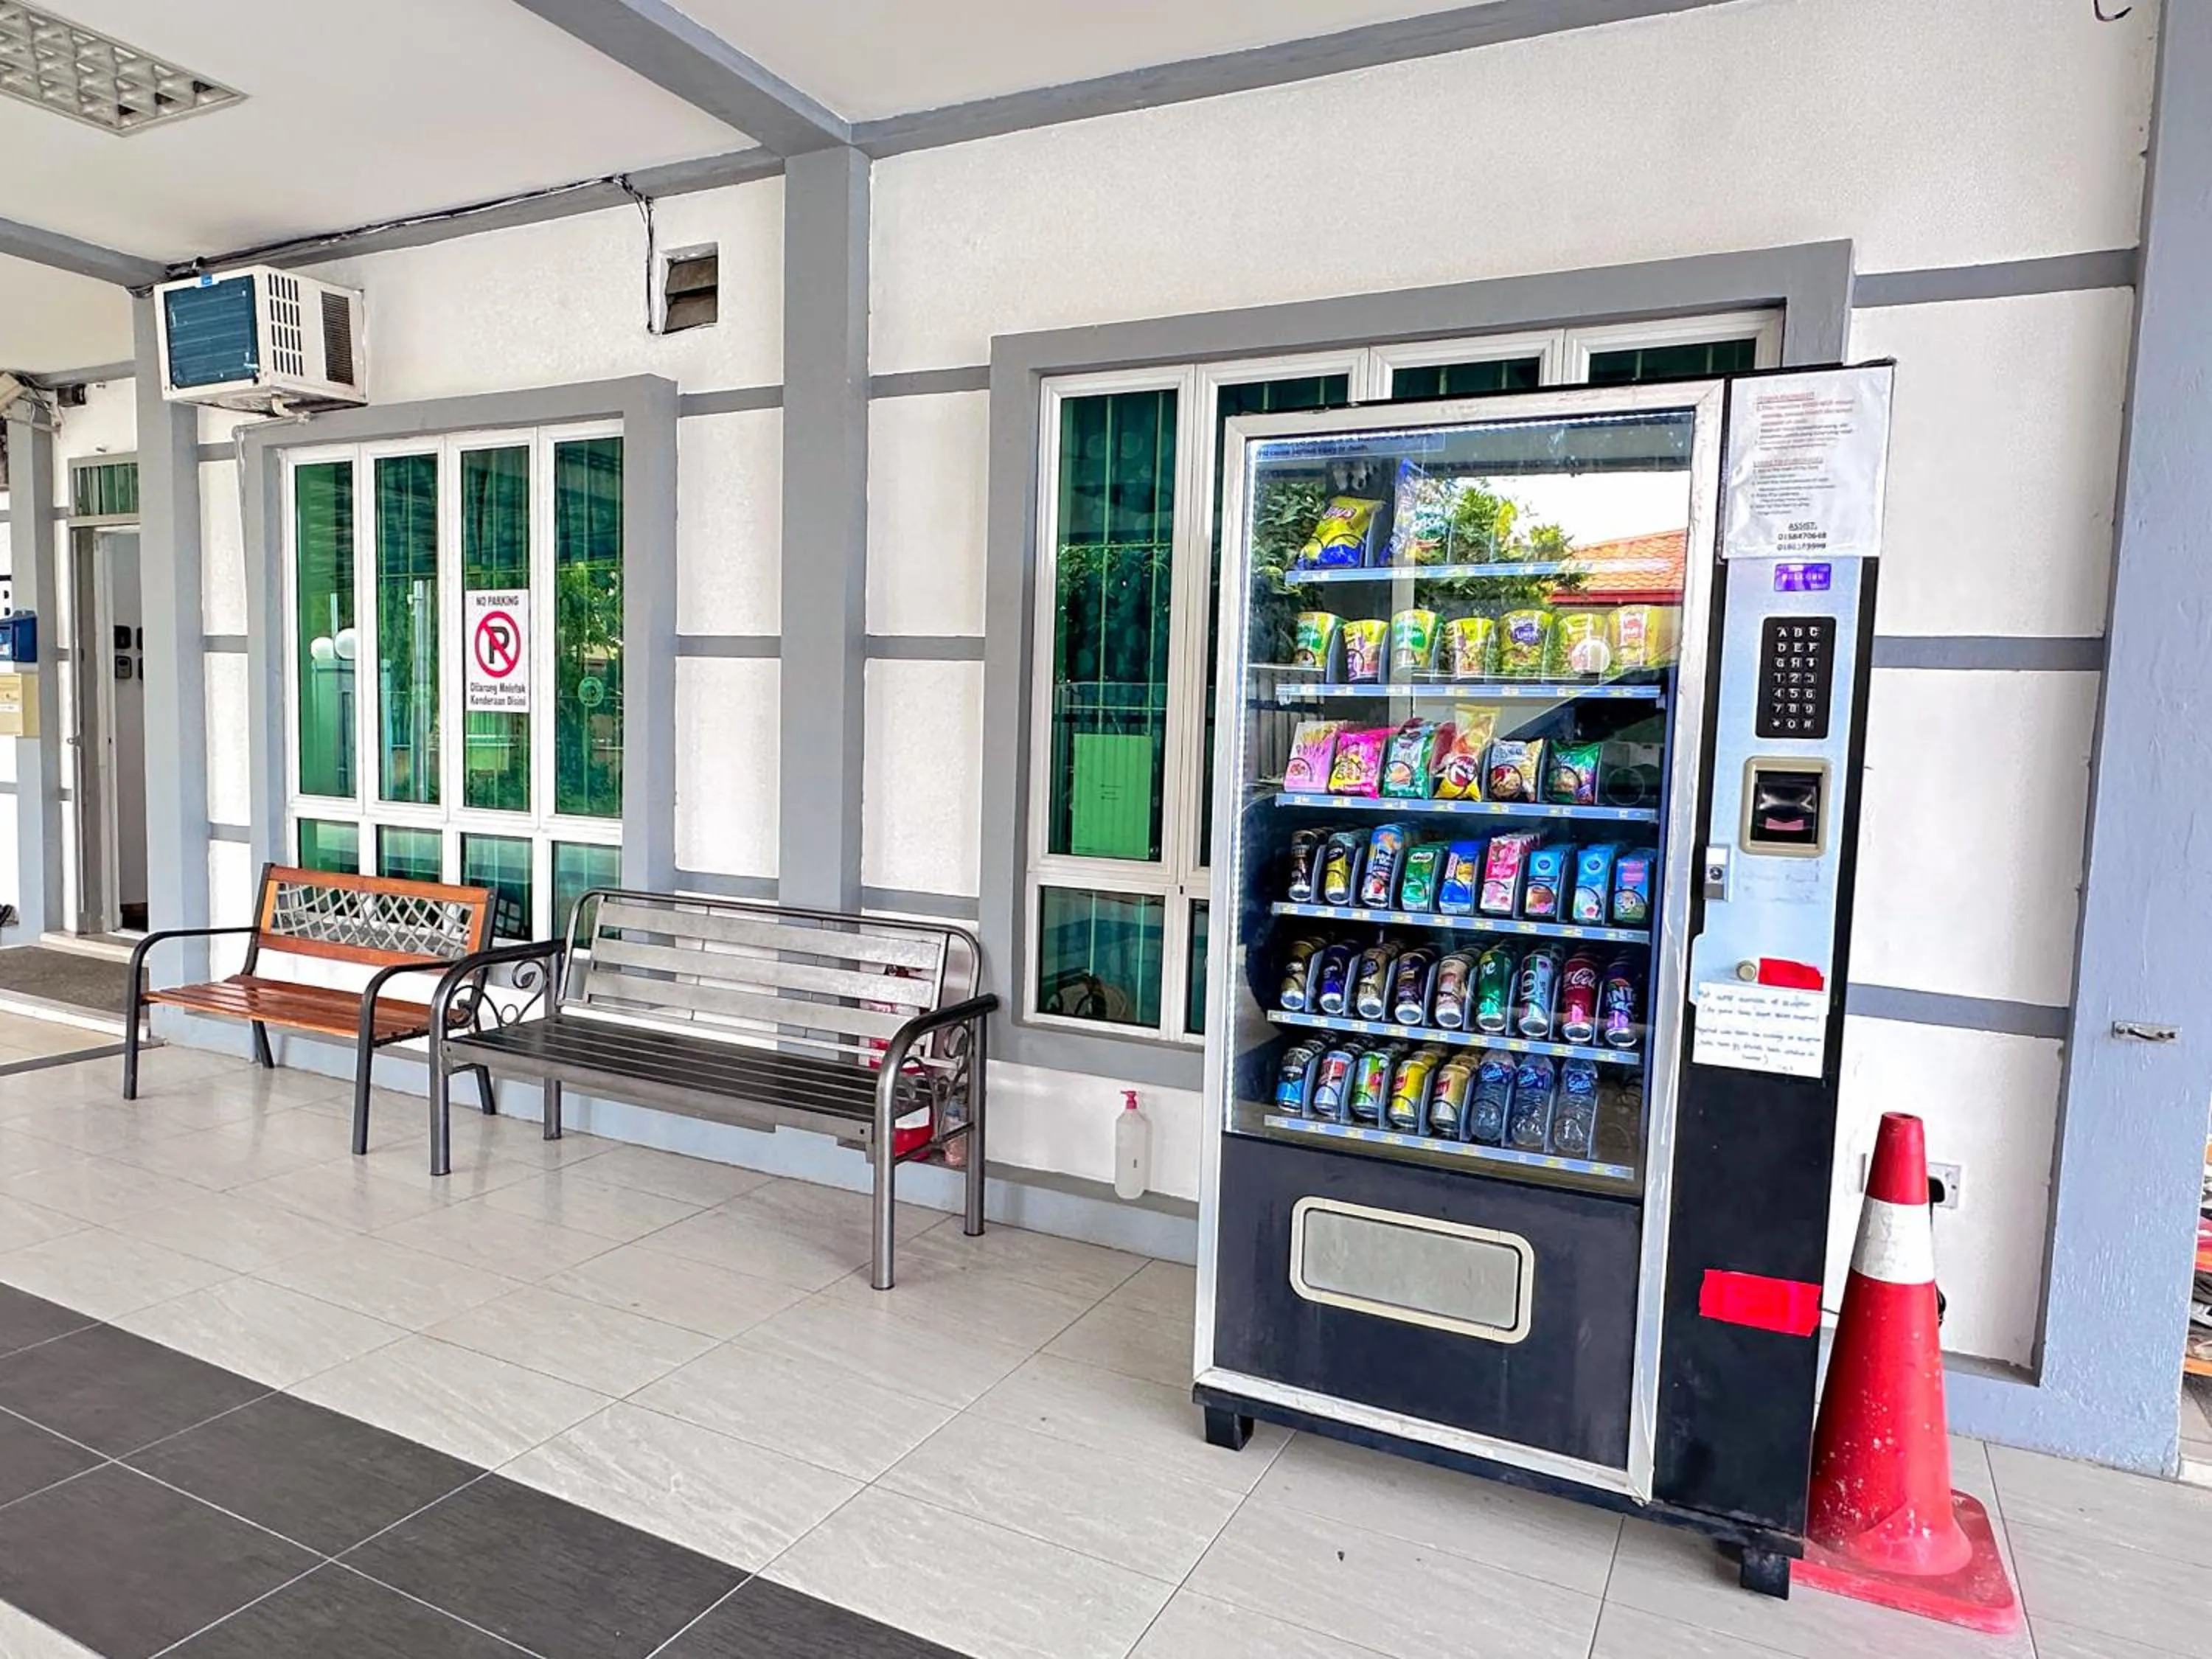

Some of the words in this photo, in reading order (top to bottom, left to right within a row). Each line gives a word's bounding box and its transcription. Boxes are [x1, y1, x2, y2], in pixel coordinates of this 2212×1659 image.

[476, 596, 486, 606] NO
[487, 595, 519, 606] PARKING
[1778, 627, 1787, 637] A
[1794, 627, 1803, 637] B
[1809, 627, 1818, 636] C
[1778, 642, 1787, 653] D
[1794, 642, 1803, 653] E
[1809, 642, 1818, 652] F
[1776, 658, 1784, 667] G
[1791, 673, 1799, 683] 2
[470, 681, 498, 695] Dilarang
[1790, 688, 1799, 698] 5
[470, 695, 506, 706] Kenderaan
[507, 695, 526, 706] Disini
[1789, 703, 1797, 713] 8
[1787, 719, 1796, 728] 0
